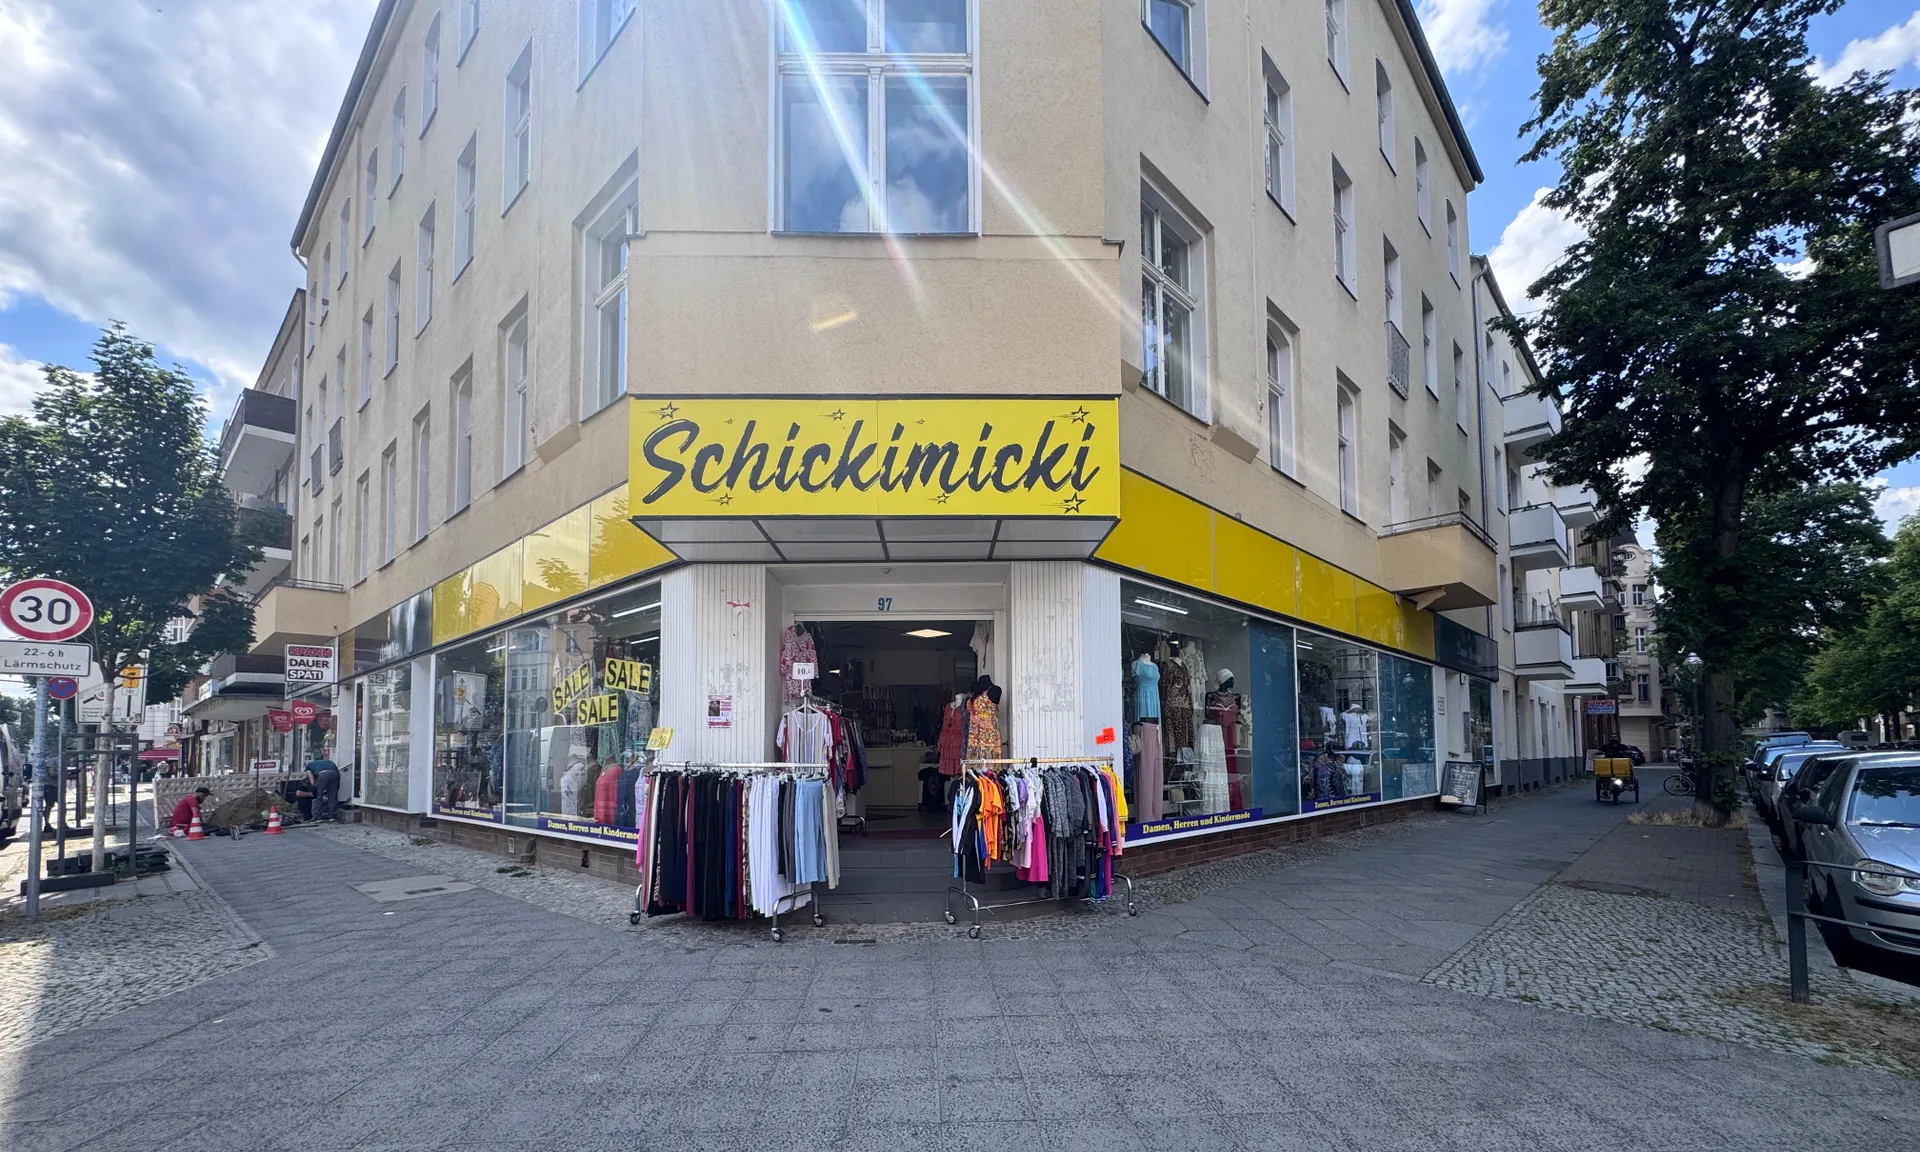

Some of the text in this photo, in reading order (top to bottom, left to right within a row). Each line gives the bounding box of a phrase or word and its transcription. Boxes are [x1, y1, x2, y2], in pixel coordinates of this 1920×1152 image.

[642, 418, 1100, 504] Schickimicki
[18, 595, 72, 625] 30
[877, 597, 893, 611] 97
[58, 650, 64, 658] h
[4, 659, 81, 671] Lärmschutz
[289, 659, 329, 668] DAUER
[289, 668, 322, 679] SPÄTI
[606, 660, 651, 692] SALE
[554, 664, 589, 710] SALE
[579, 695, 618, 724] SALE
[547, 820, 567, 831] Damen,
[568, 823, 589, 833] Herren
[590, 825, 602, 834] und
[1143, 811, 1250, 834] Damen, Herren und Kindermode
